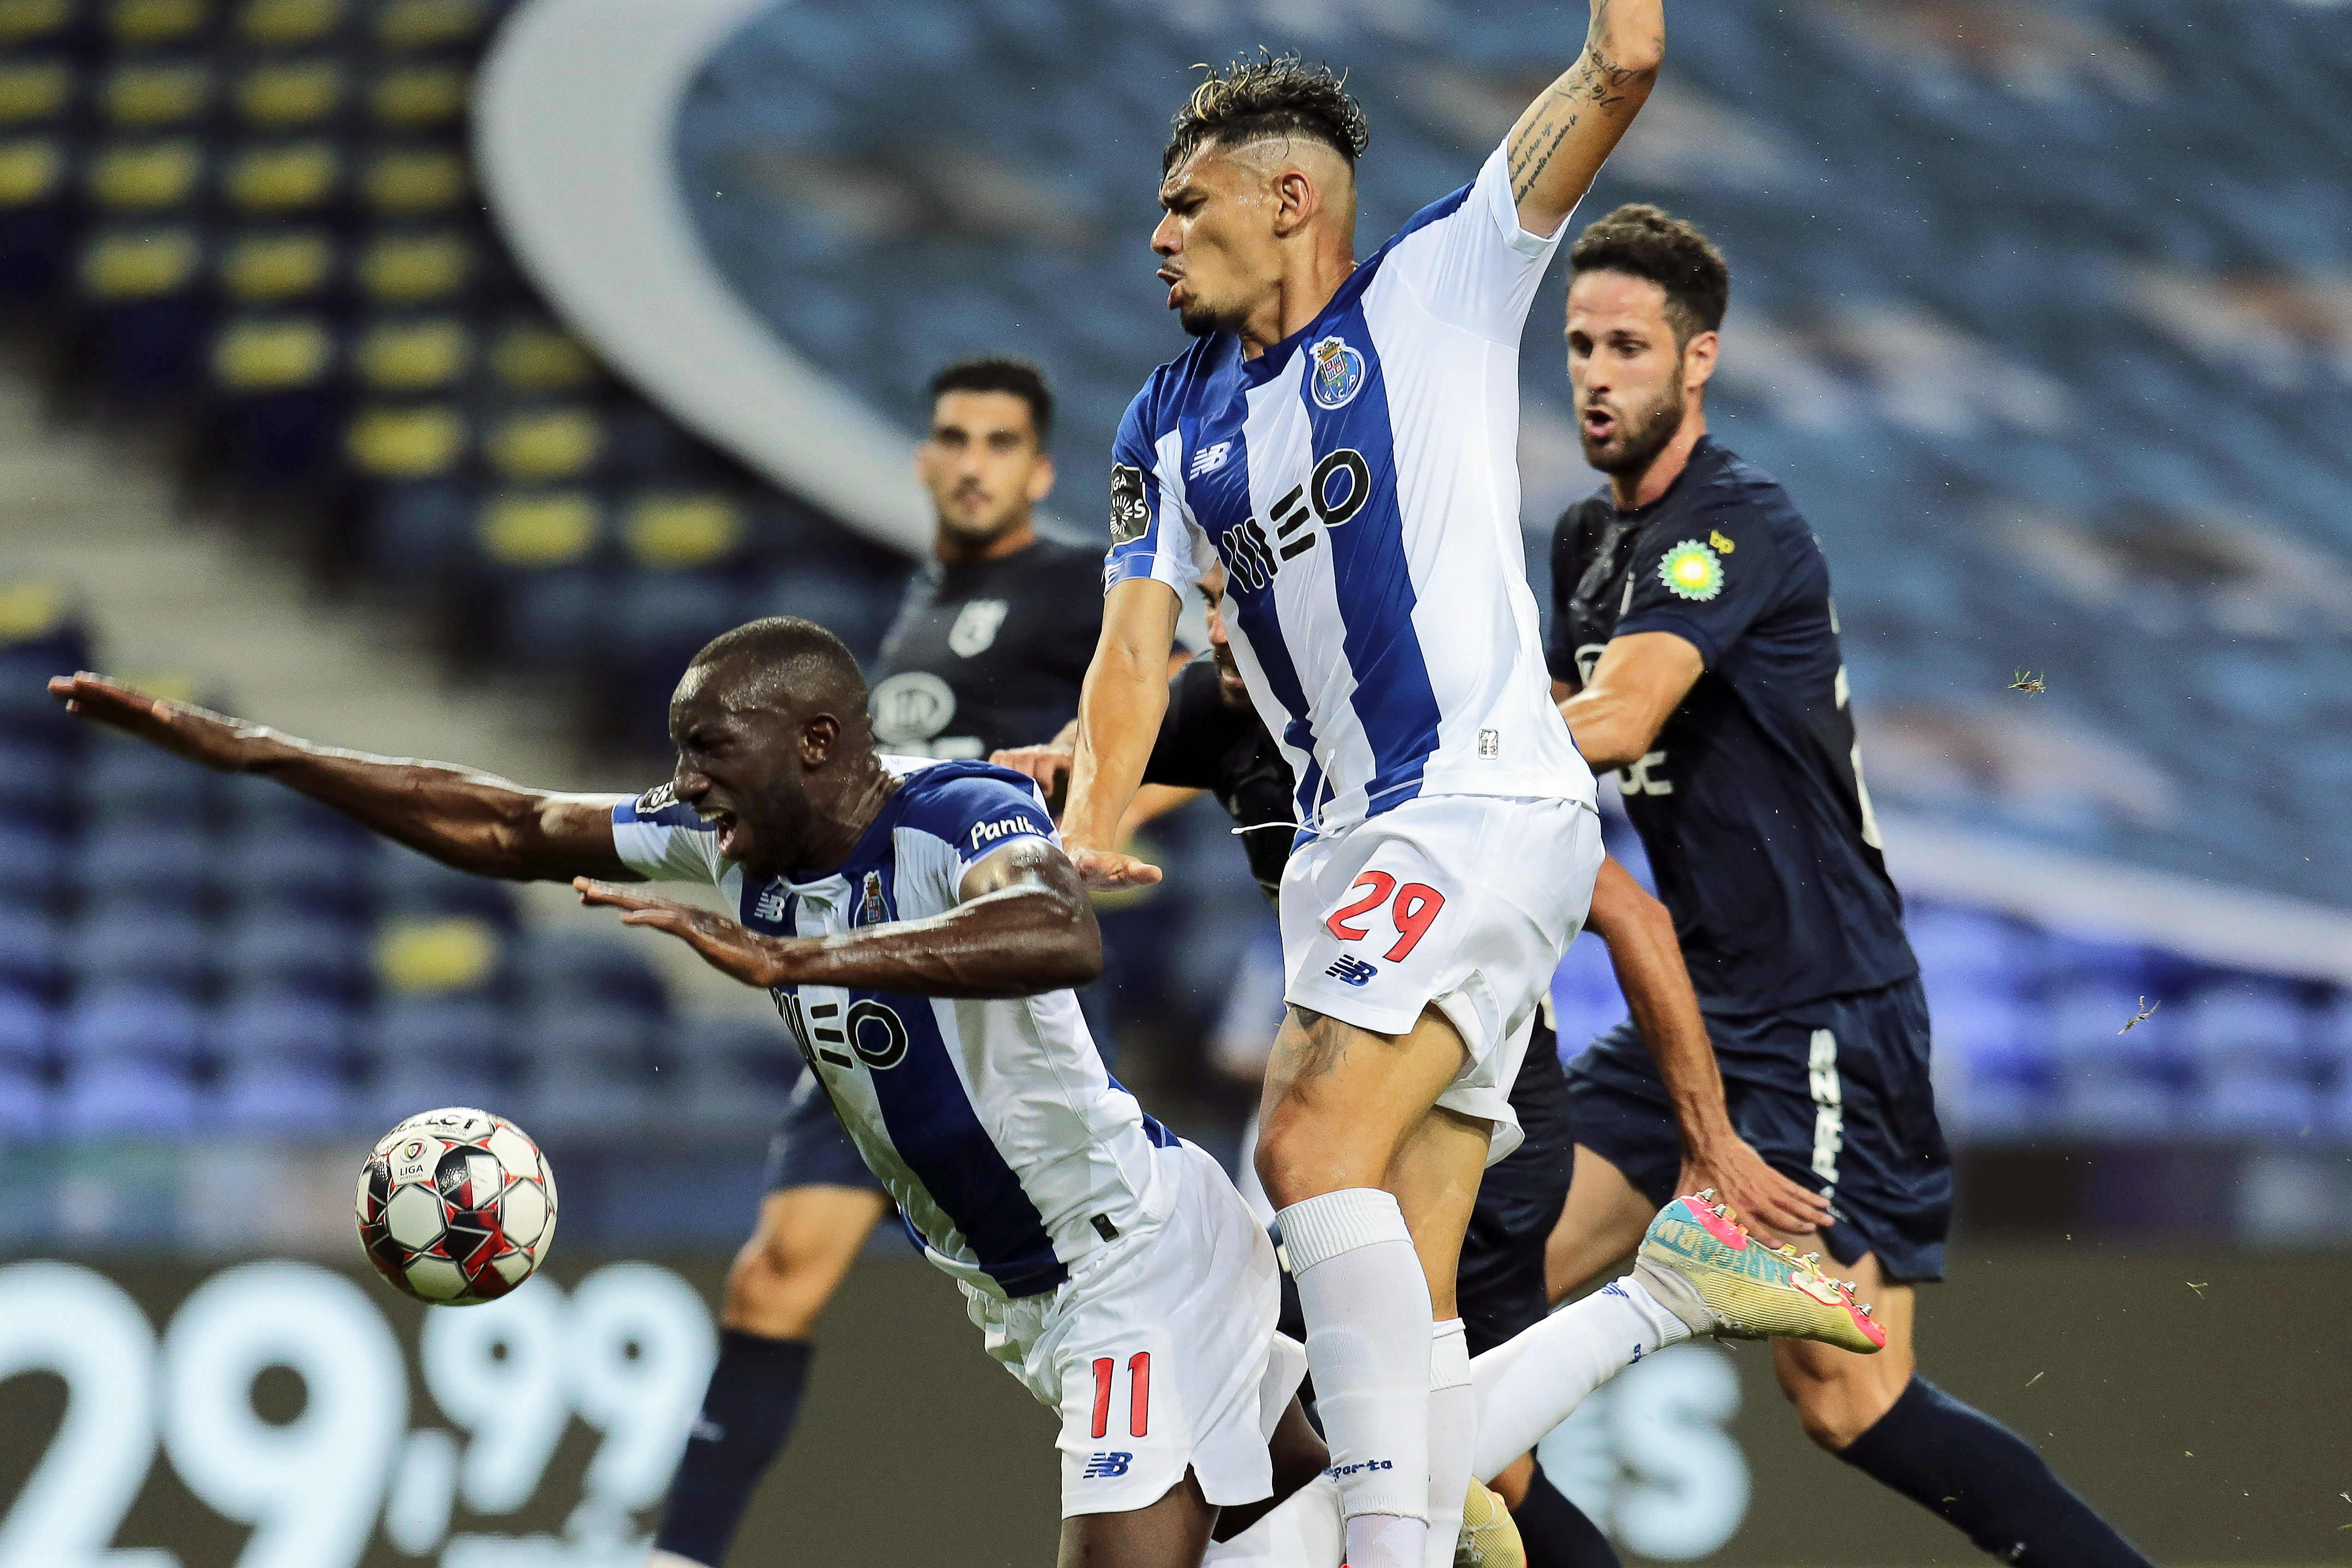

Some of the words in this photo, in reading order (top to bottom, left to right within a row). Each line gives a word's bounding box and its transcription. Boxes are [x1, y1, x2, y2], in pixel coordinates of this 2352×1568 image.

[1222, 447, 1371, 594] MEO
[1326, 870, 1446, 963] 29
[400, 1164, 423, 1176] LIGA
[1091, 1352, 1151, 1438] 11
